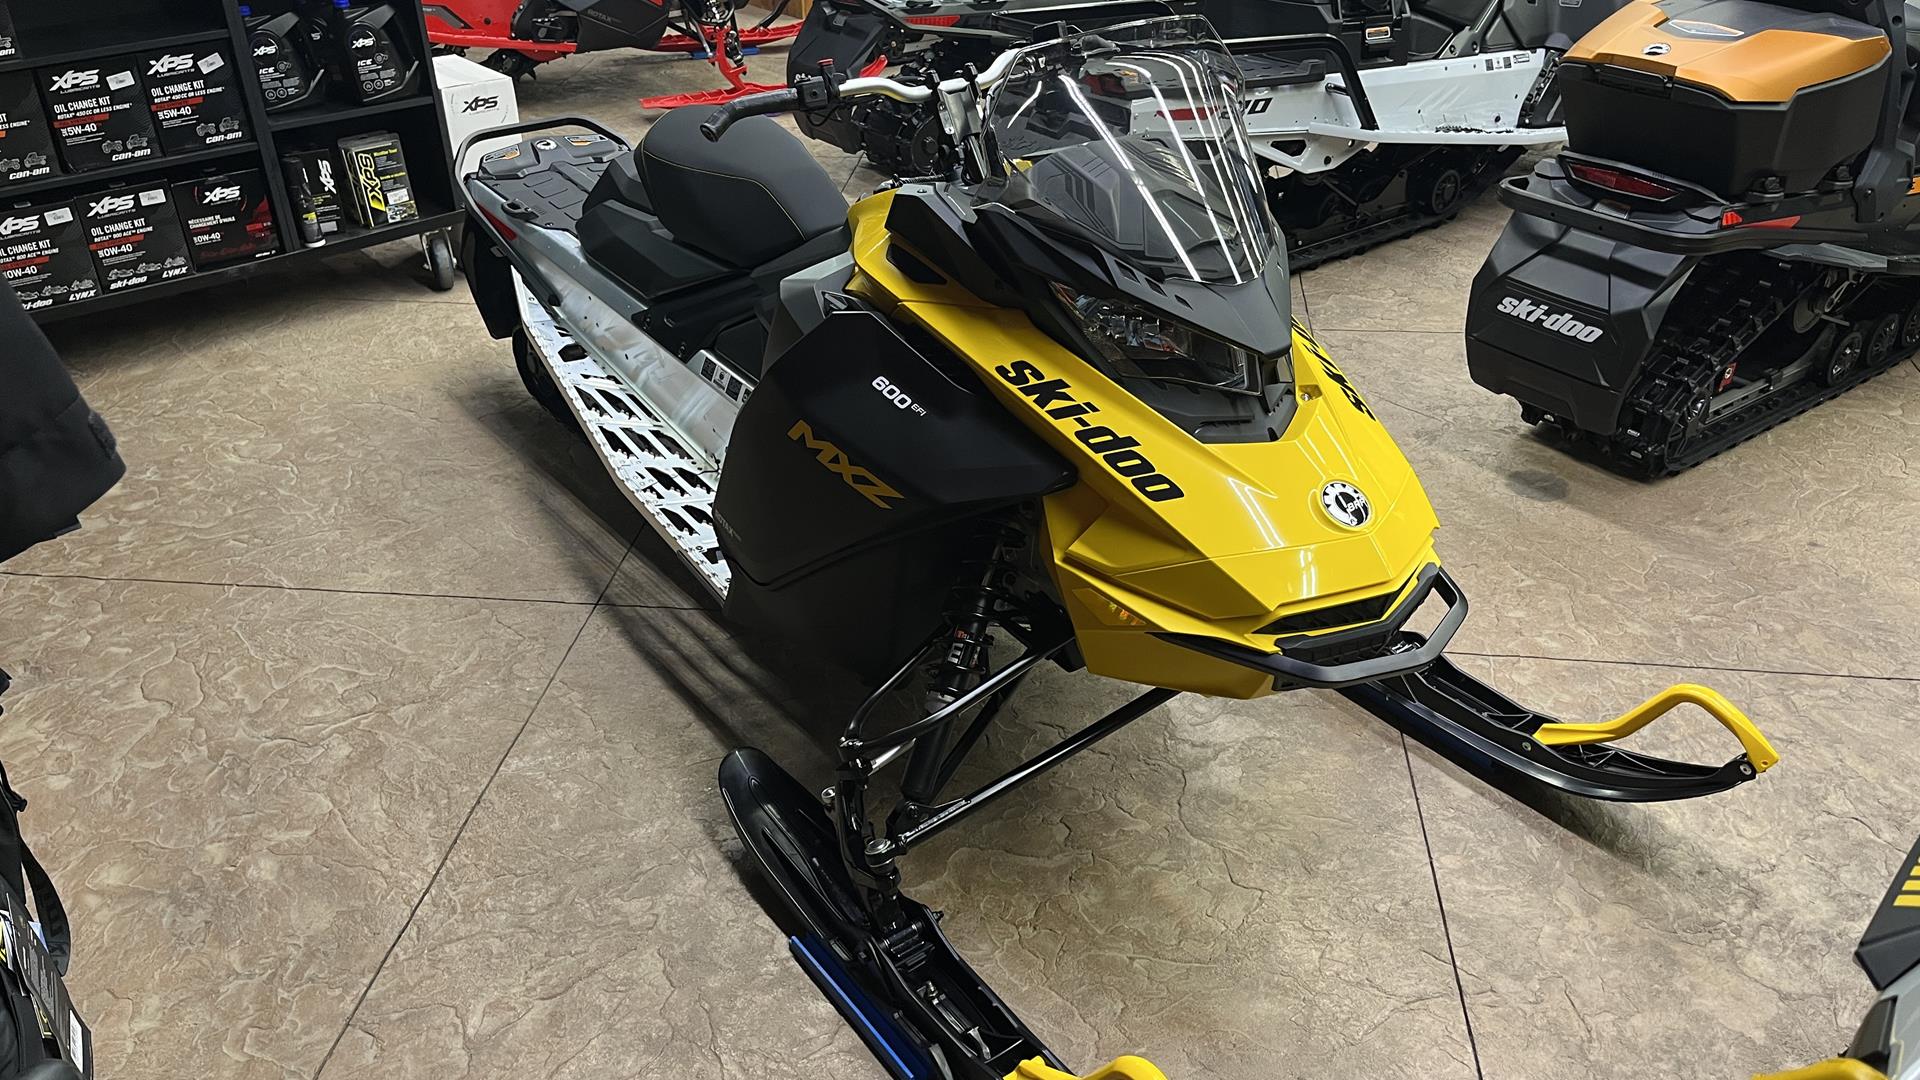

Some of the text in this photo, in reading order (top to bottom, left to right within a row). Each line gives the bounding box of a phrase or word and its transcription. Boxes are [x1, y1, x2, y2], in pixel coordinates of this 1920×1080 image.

[253, 46, 276, 57] XPS
[352, 37, 374, 49] XPS
[146, 53, 194, 76] XPS
[49, 69, 100, 92] XPS
[151, 80, 205, 97] OIL CHANGE KIT
[54, 95, 111, 114] OIL CHANGE KIT
[164, 106, 192, 119] 5W-40
[461, 95, 499, 114] XPS
[67, 123, 97, 136] 5W-40
[318, 159, 337, 194] XPS
[358, 153, 386, 212] XPS
[203, 185, 241, 204] XPS
[86, 194, 135, 218] XPS
[91, 217, 146, 237] OIL CHANGE KIT
[7, 241, 39, 255] CHANGE
[39, 239, 52, 249] KIT
[162, 265, 189, 279] LYNX
[109, 275, 148, 290] ski-doo
[69, 289, 97, 301] LYNX
[1496, 296, 1603, 344] ski-doo
[871, 375, 927, 417] 600 EFI
[995, 359, 1185, 503] ski-doo
[786, 419, 905, 511] MXZ
